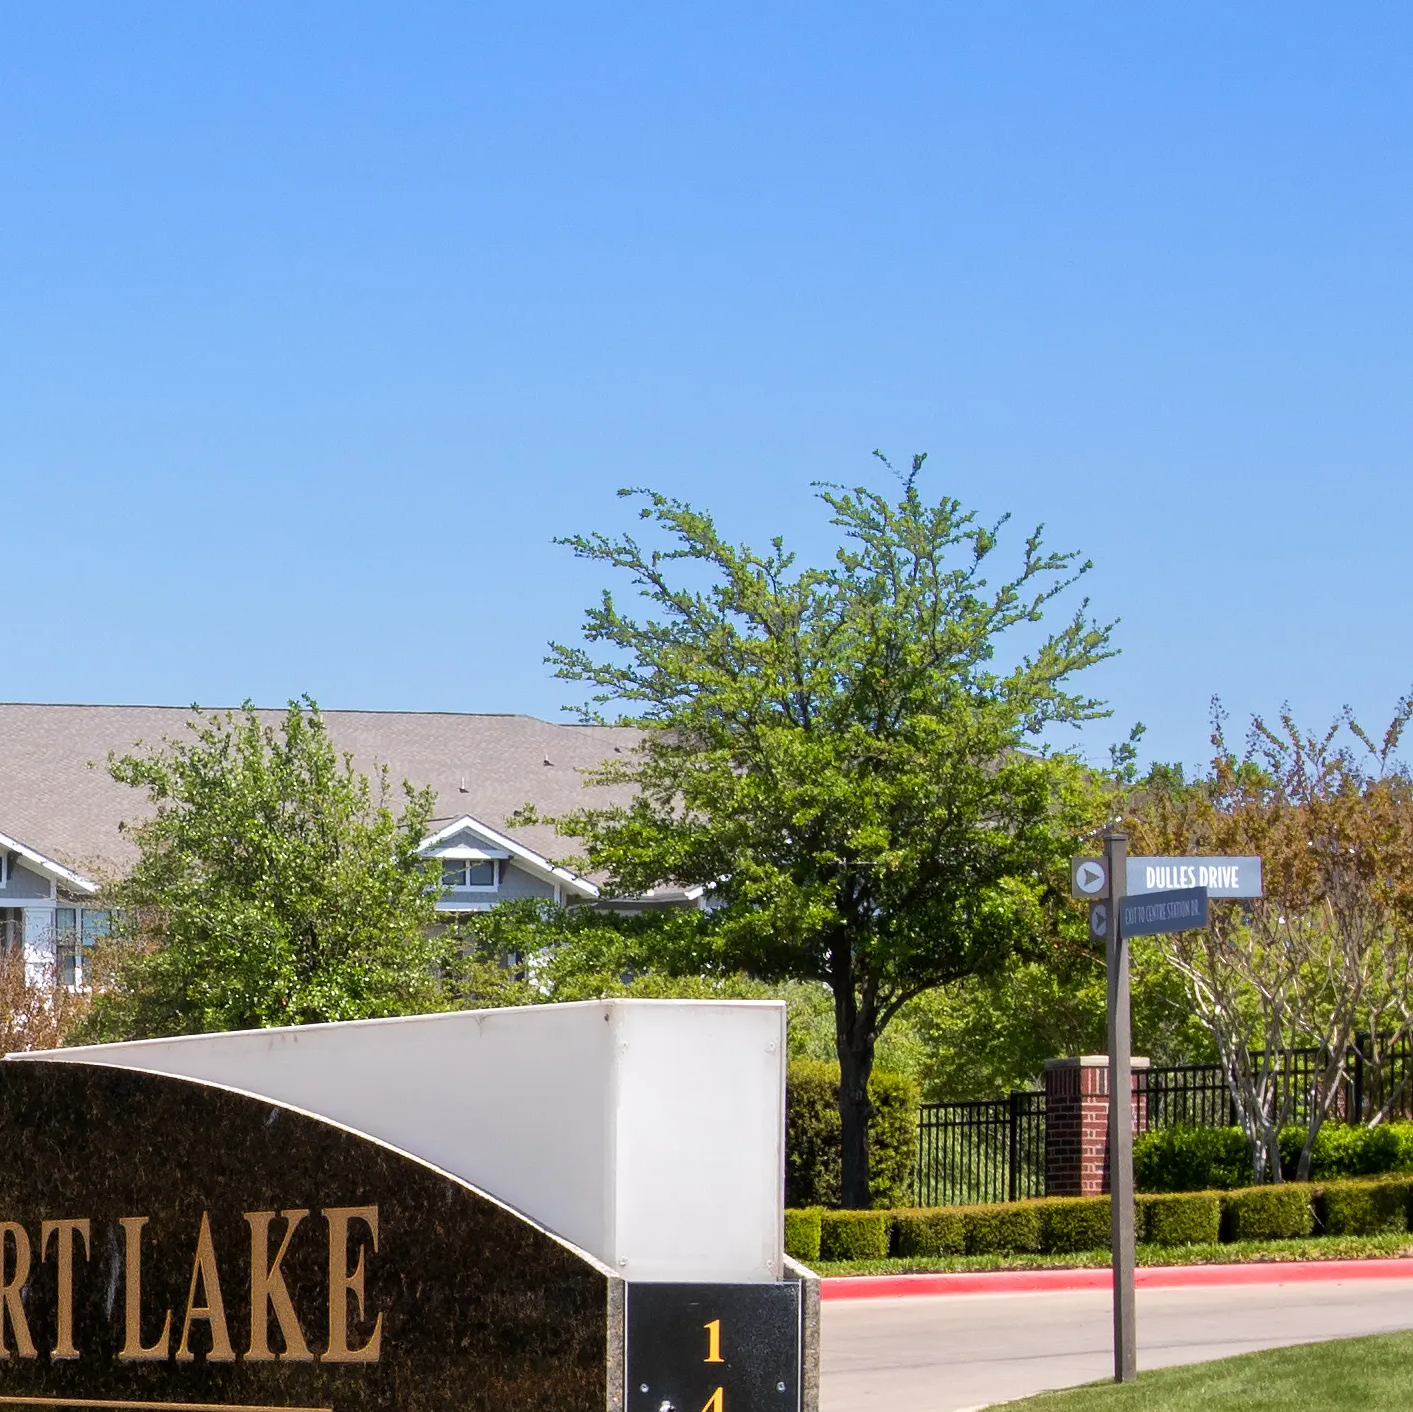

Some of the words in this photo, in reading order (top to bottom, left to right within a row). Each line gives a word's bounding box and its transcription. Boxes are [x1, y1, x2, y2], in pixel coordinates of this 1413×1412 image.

[1146, 866, 1195, 889] DULLES
[1199, 866, 1240, 889] DRIVE
[1137, 906, 1146, 923] TO
[119, 1205, 383, 1363] LAKE
